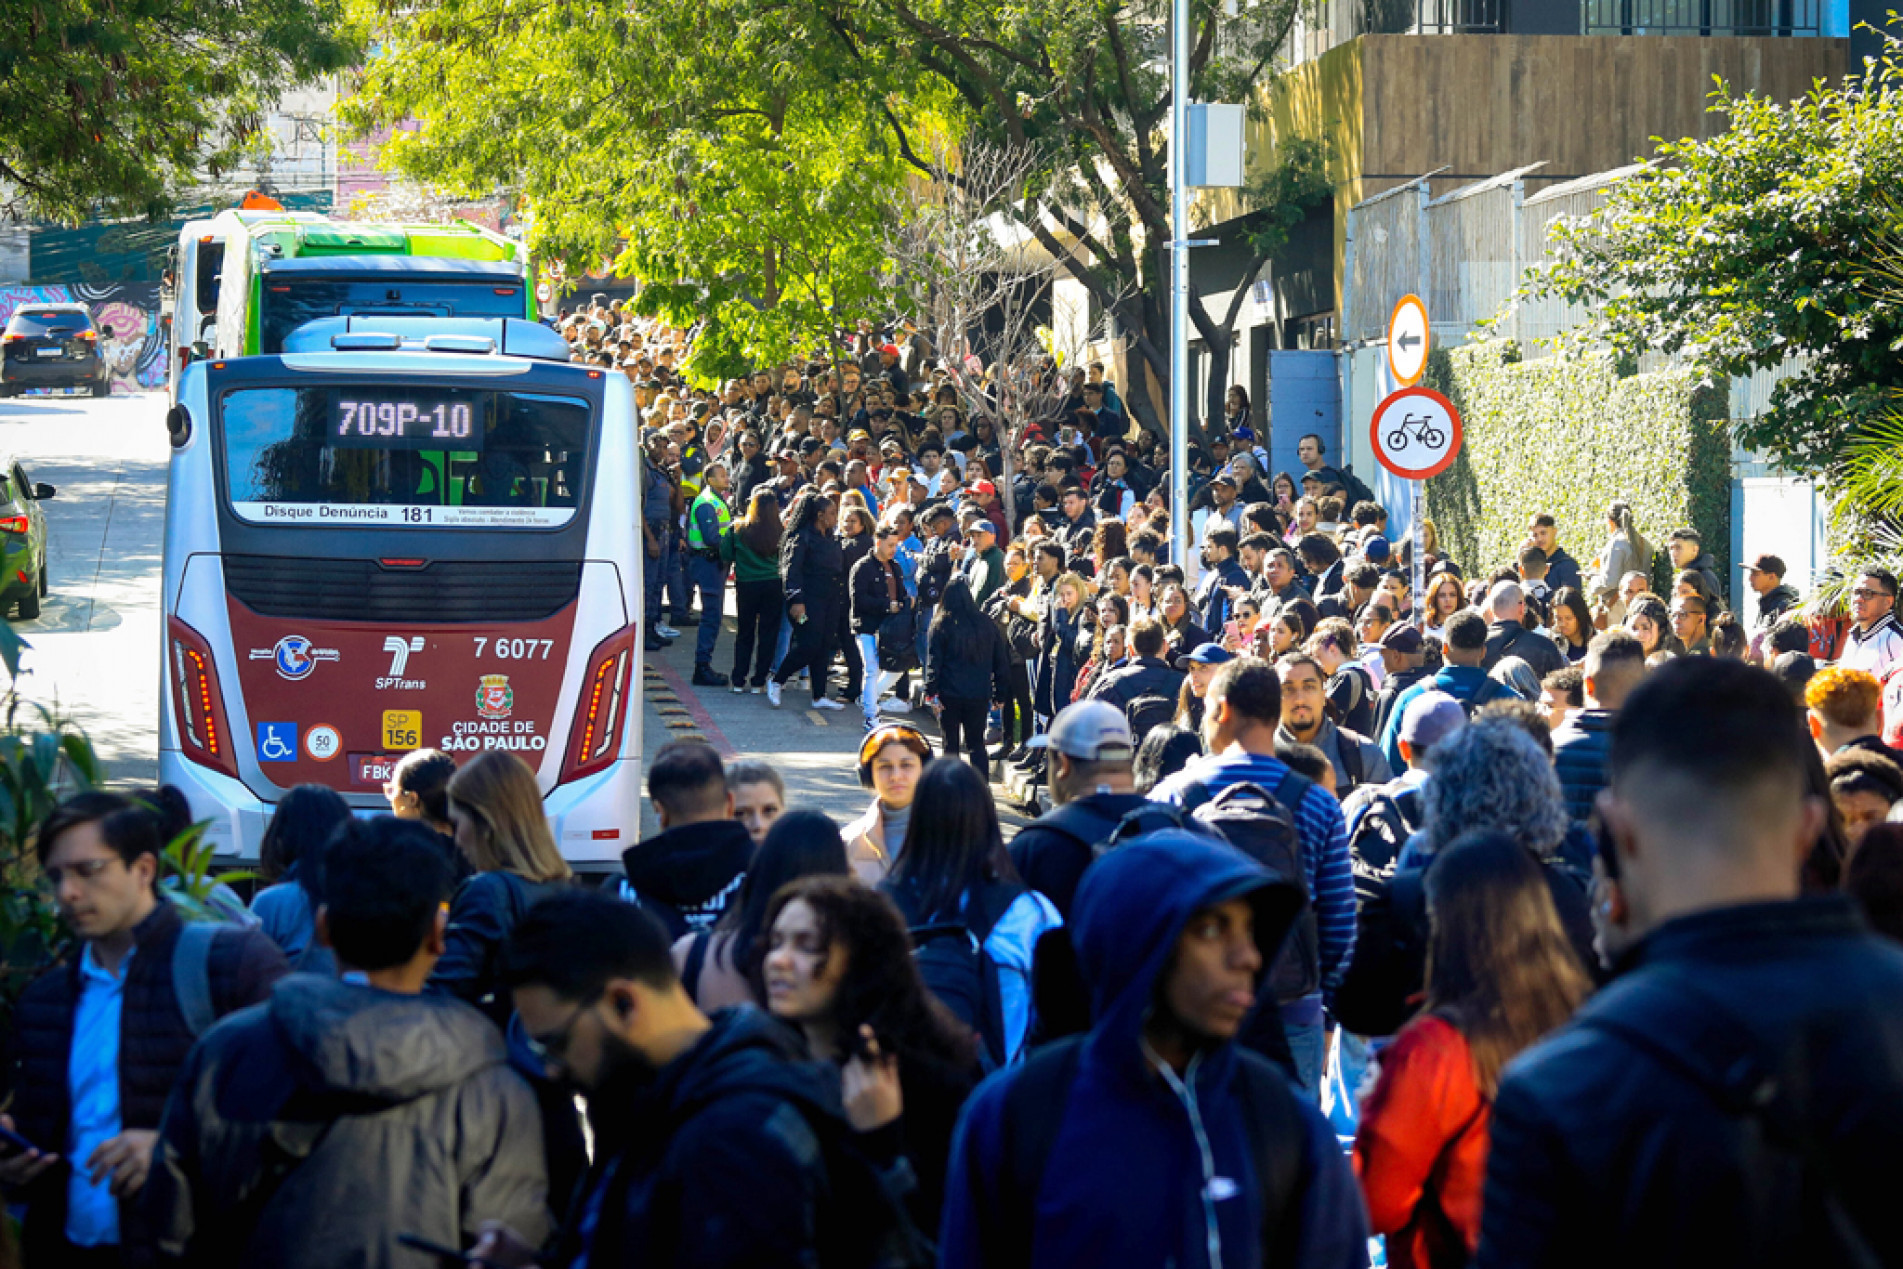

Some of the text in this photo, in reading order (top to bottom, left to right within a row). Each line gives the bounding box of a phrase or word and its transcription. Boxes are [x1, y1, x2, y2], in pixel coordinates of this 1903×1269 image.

[339, 402, 471, 437] 709P-10
[264, 505, 432, 522] Disque Denúncia 181
[473, 637, 554, 659] 7 6077
[375, 678, 426, 690] SPTrans
[386, 713, 409, 729] SP
[452, 721, 535, 733] CIDADE DE
[315, 735, 331, 747] 50
[387, 730, 417, 746] 156
[441, 732, 546, 750] SÃO PAULO
